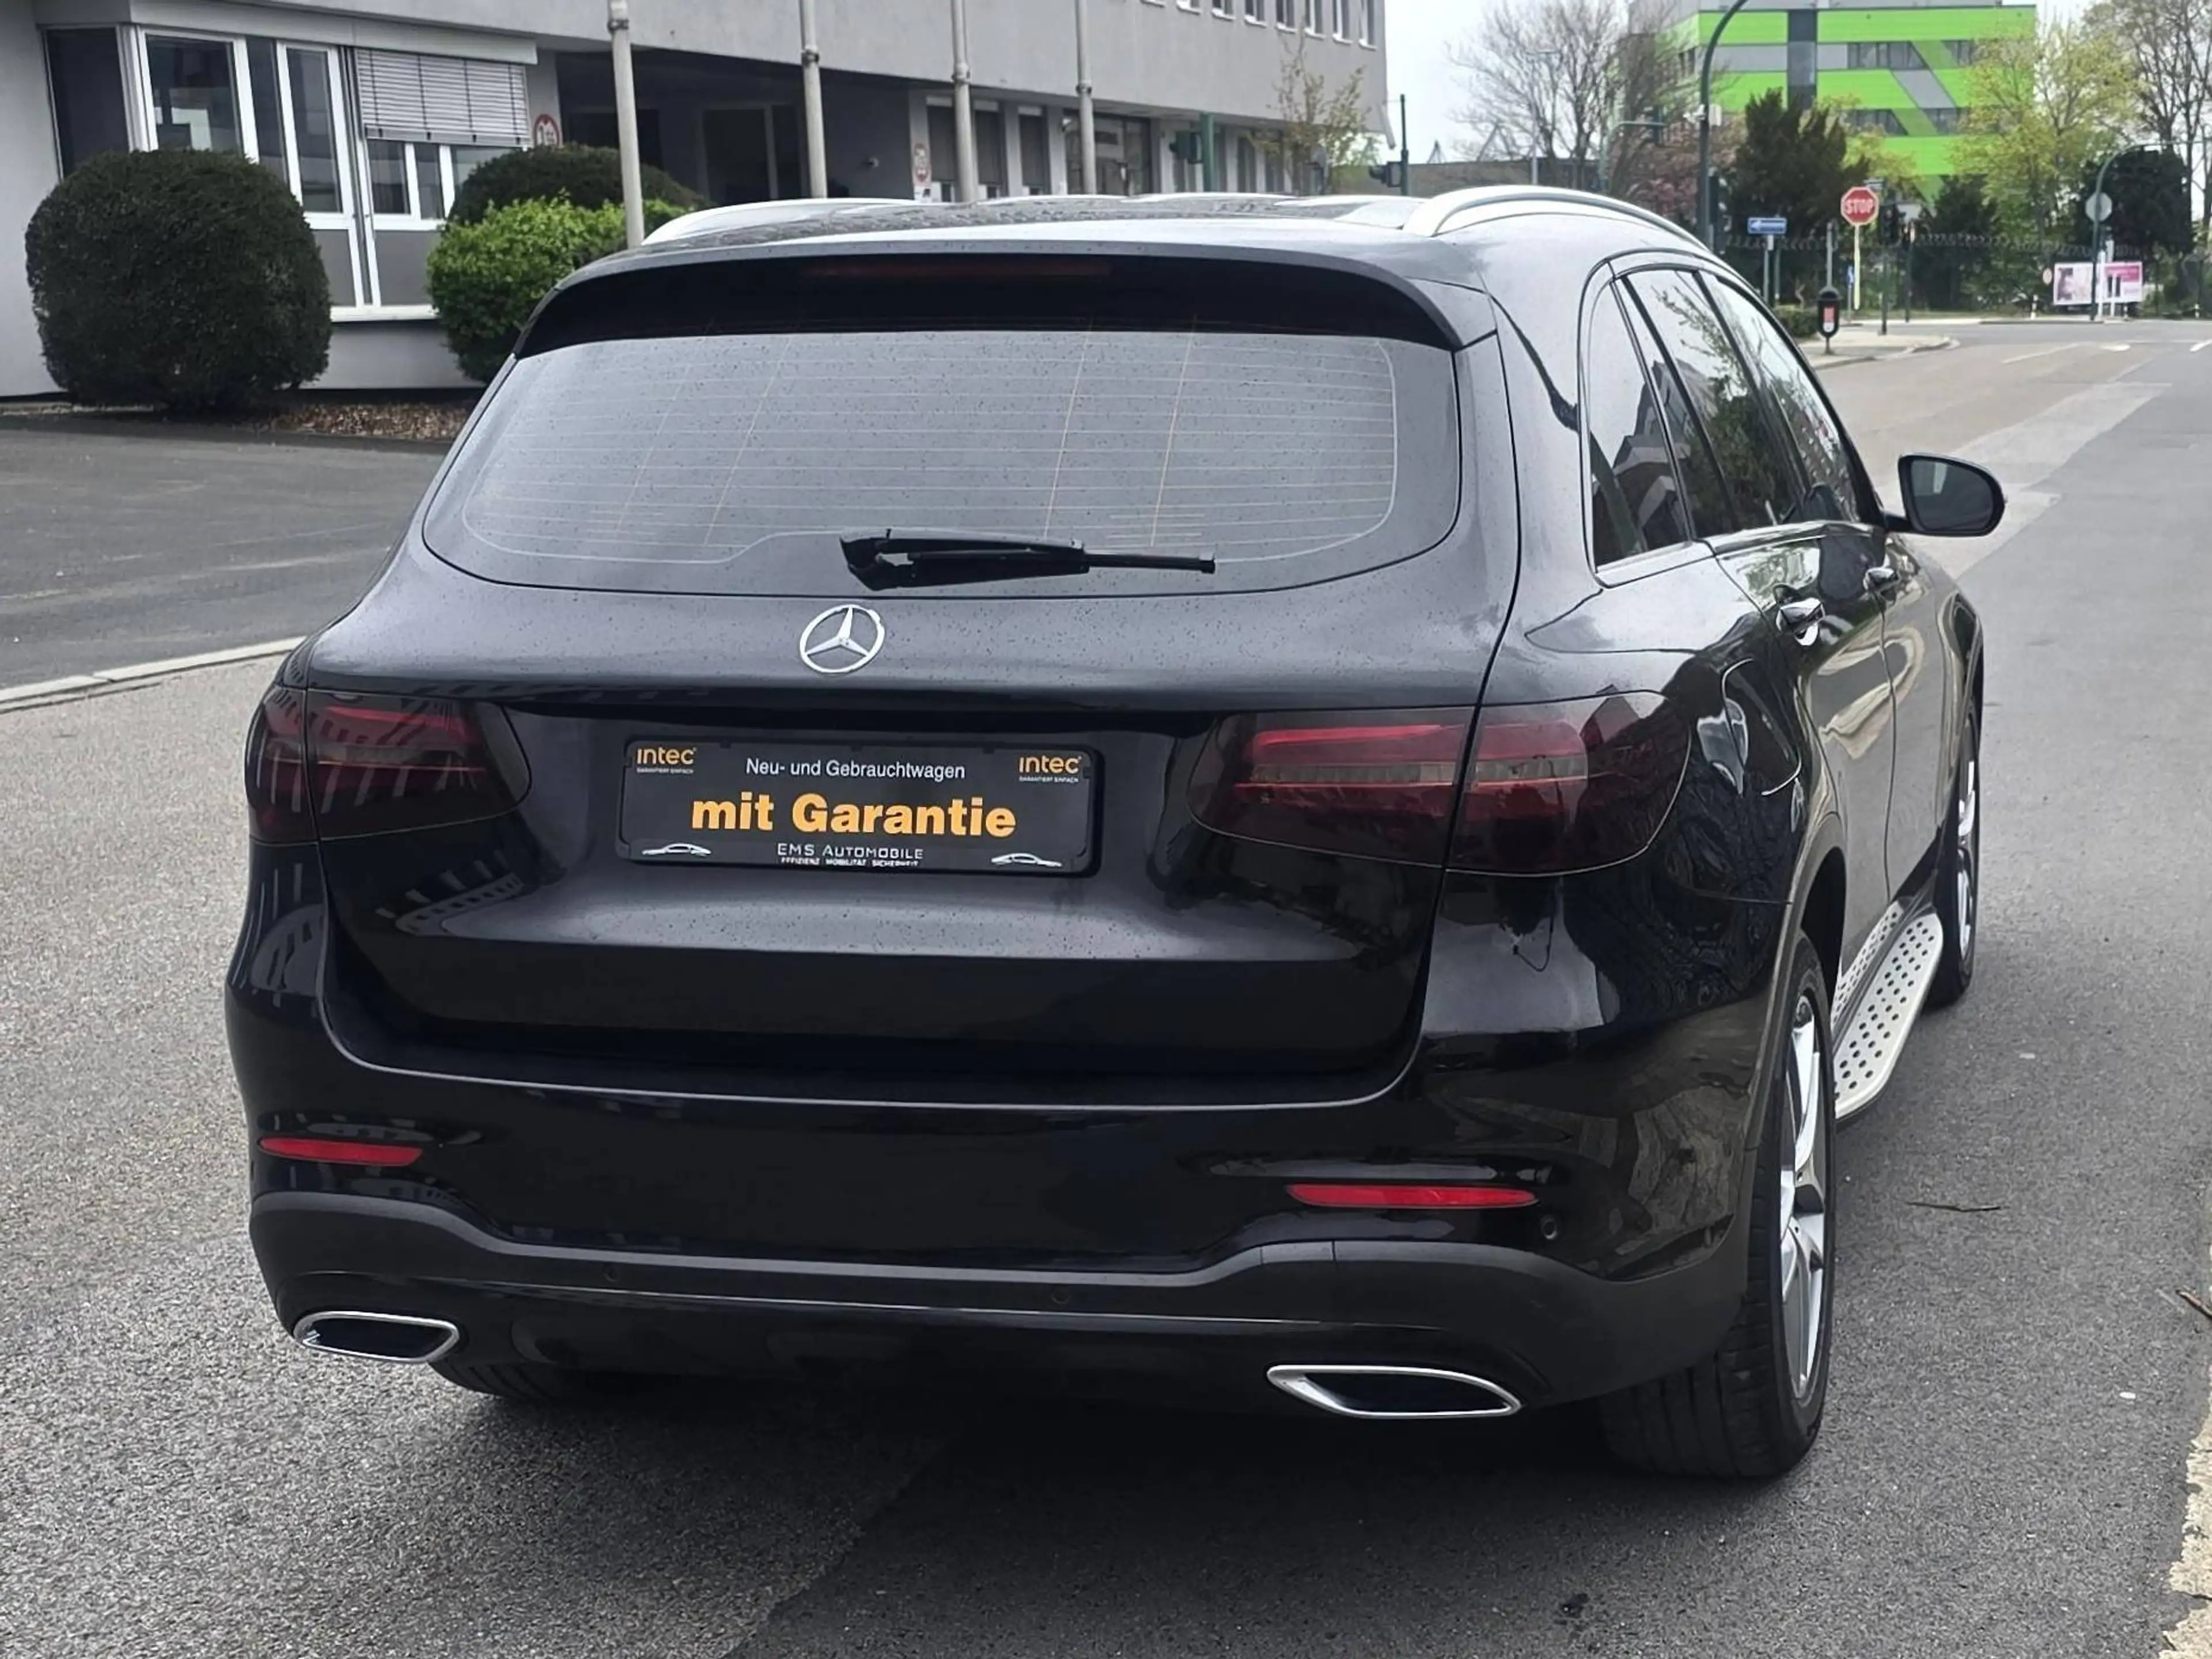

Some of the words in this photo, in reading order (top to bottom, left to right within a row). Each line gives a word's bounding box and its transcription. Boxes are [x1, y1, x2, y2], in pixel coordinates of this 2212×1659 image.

[1846, 198, 1873, 214] STOP
[746, 757, 785, 774] Neu-
[791, 760, 821, 776] und
[825, 760, 965, 782] Gebrauchtwagen
[692, 791, 774, 830] mit
[792, 793, 1016, 838] Garantie
[778, 843, 815, 857] EMS
